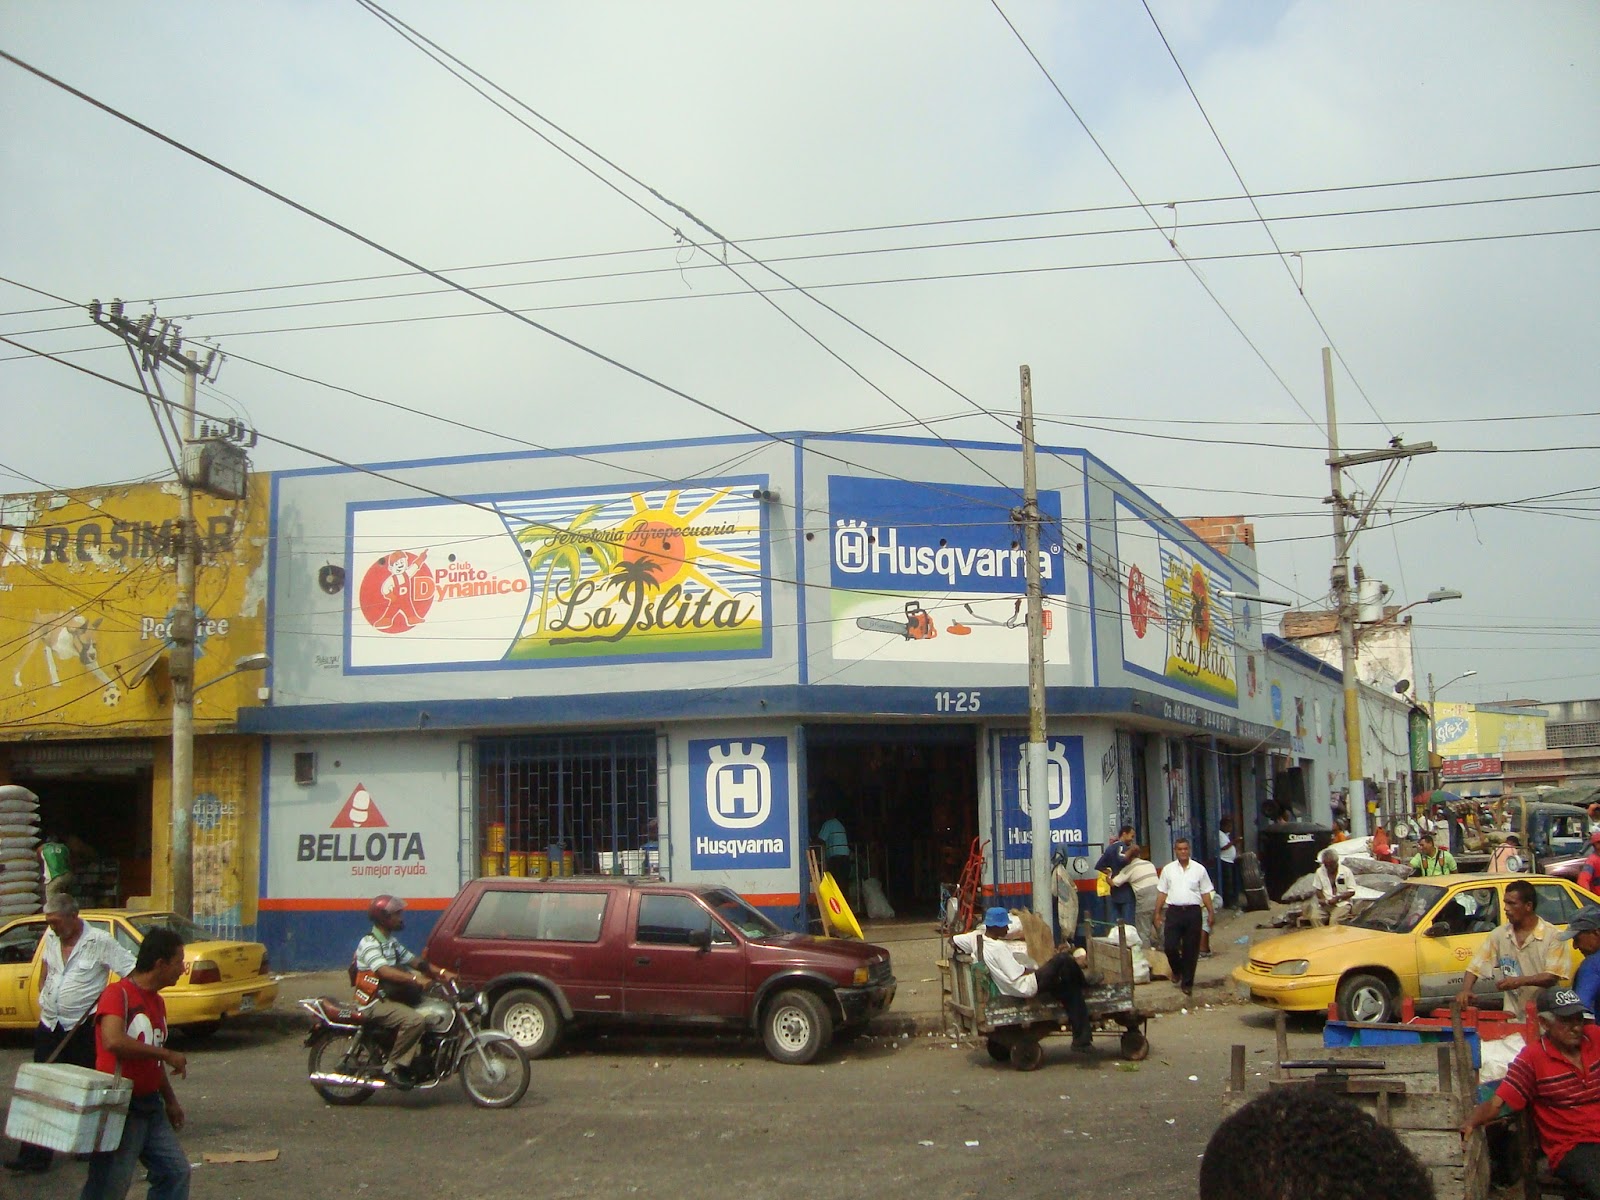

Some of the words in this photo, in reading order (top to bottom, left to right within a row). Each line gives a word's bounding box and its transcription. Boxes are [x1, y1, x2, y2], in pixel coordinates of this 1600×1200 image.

[627, 519, 736, 546] Agropecuaria
[448, 561, 471, 571] Club
[871, 527, 1052, 584] Husqvarna
[435, 567, 488, 583] Punto
[413, 576, 528, 602] Dynamico
[549, 577, 617, 632] La
[934, 691, 981, 712] 11-25
[297, 832, 426, 861] BELLOTA
[696, 836, 784, 859] Husqvarna
[352, 866, 364, 876] su
[365, 865, 392, 878] mejor
